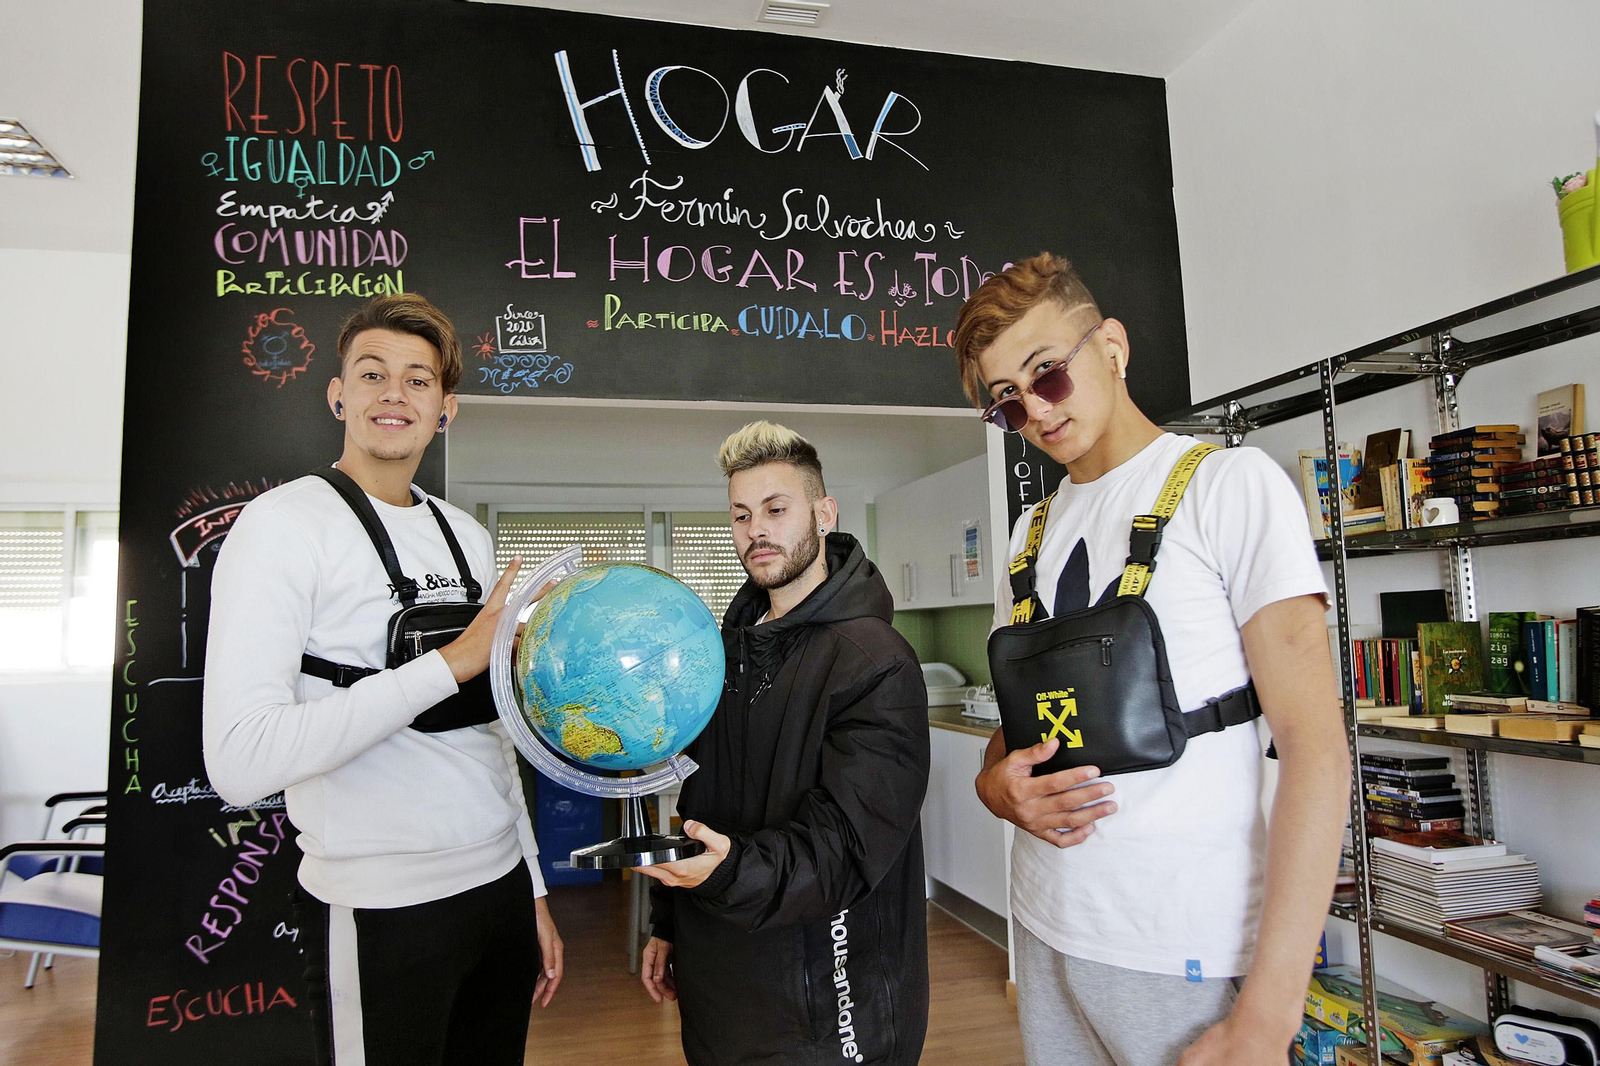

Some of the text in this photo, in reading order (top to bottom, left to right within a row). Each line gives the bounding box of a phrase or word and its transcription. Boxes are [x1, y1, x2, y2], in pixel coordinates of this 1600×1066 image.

[223, 51, 404, 142] RESPETO
[554, 48, 930, 173] HOGAR
[224, 136, 401, 187] IGUALDAD
[759, 188, 936, 242] Salvochea
[213, 222, 409, 268] COMUNIDAD
[505, 217, 576, 279] EL
[609, 234, 818, 294] HOGAR
[834, 250, 885, 300] ES
[914, 252, 1014, 306] TOD
[737, 304, 867, 341] CUIDALO
[1490, 641, 1508, 654] zig
[1491, 656, 1508, 667] zag
[146, 981, 298, 1032] ESCUCHA
